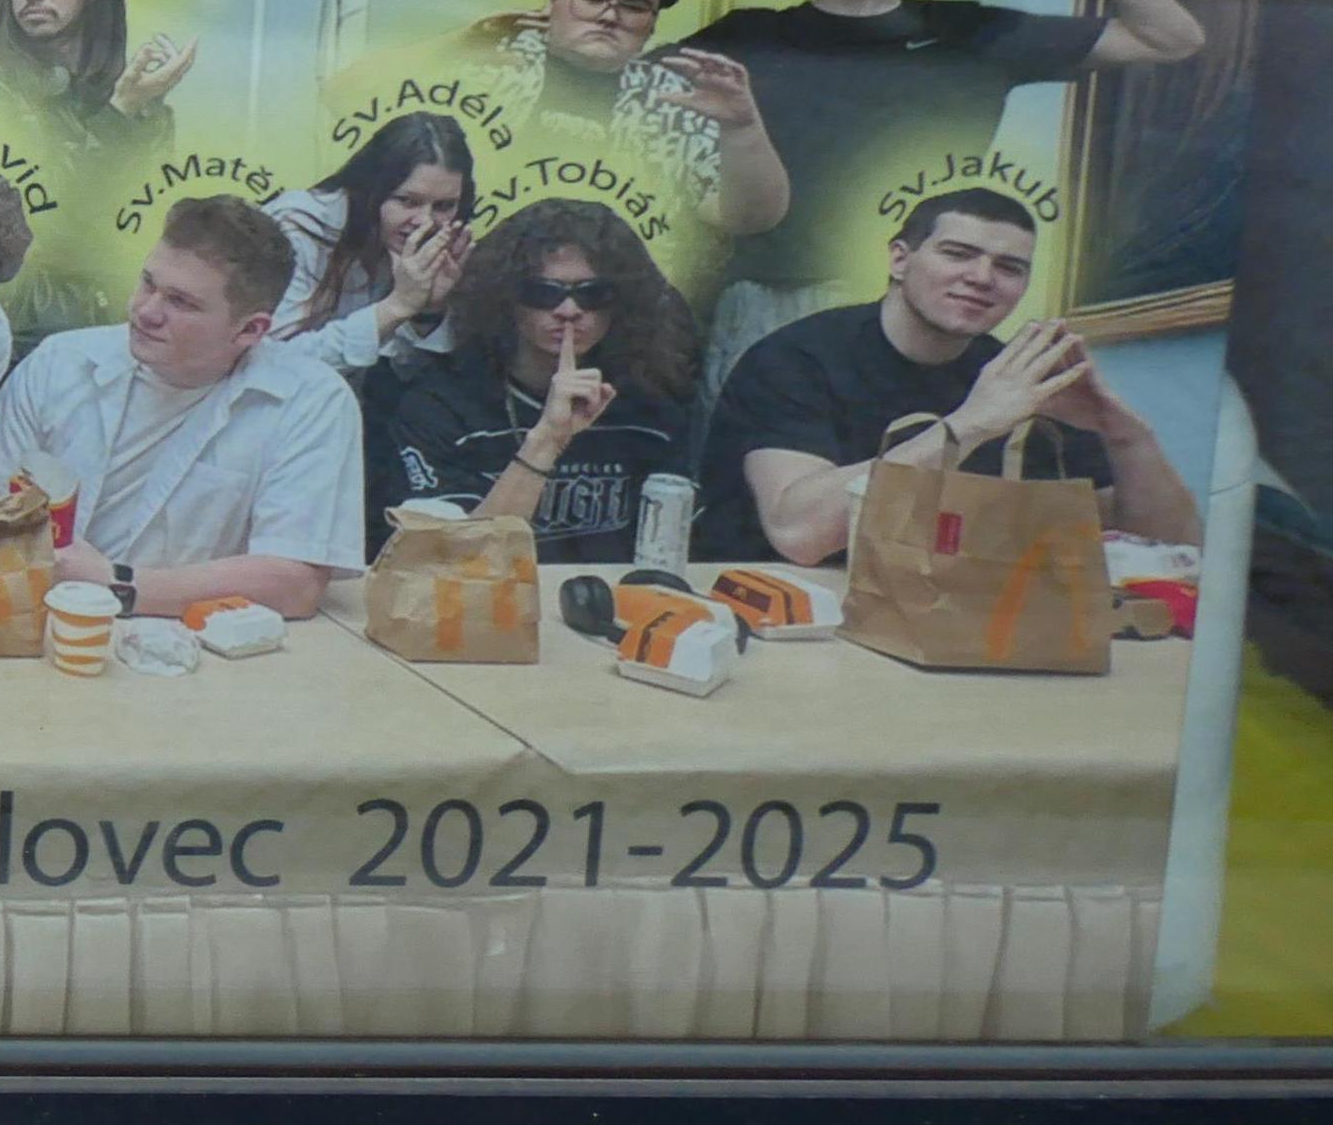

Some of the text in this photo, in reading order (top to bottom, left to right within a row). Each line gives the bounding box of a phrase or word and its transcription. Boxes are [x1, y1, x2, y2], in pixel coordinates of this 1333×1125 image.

[332, 78, 514, 151] Sv.Adéla
[471, 156, 672, 244] Sv.Tobiáš
[879, 150, 1061, 225] Sv.Jakub
[347, 797, 944, 893] 2021-2025
